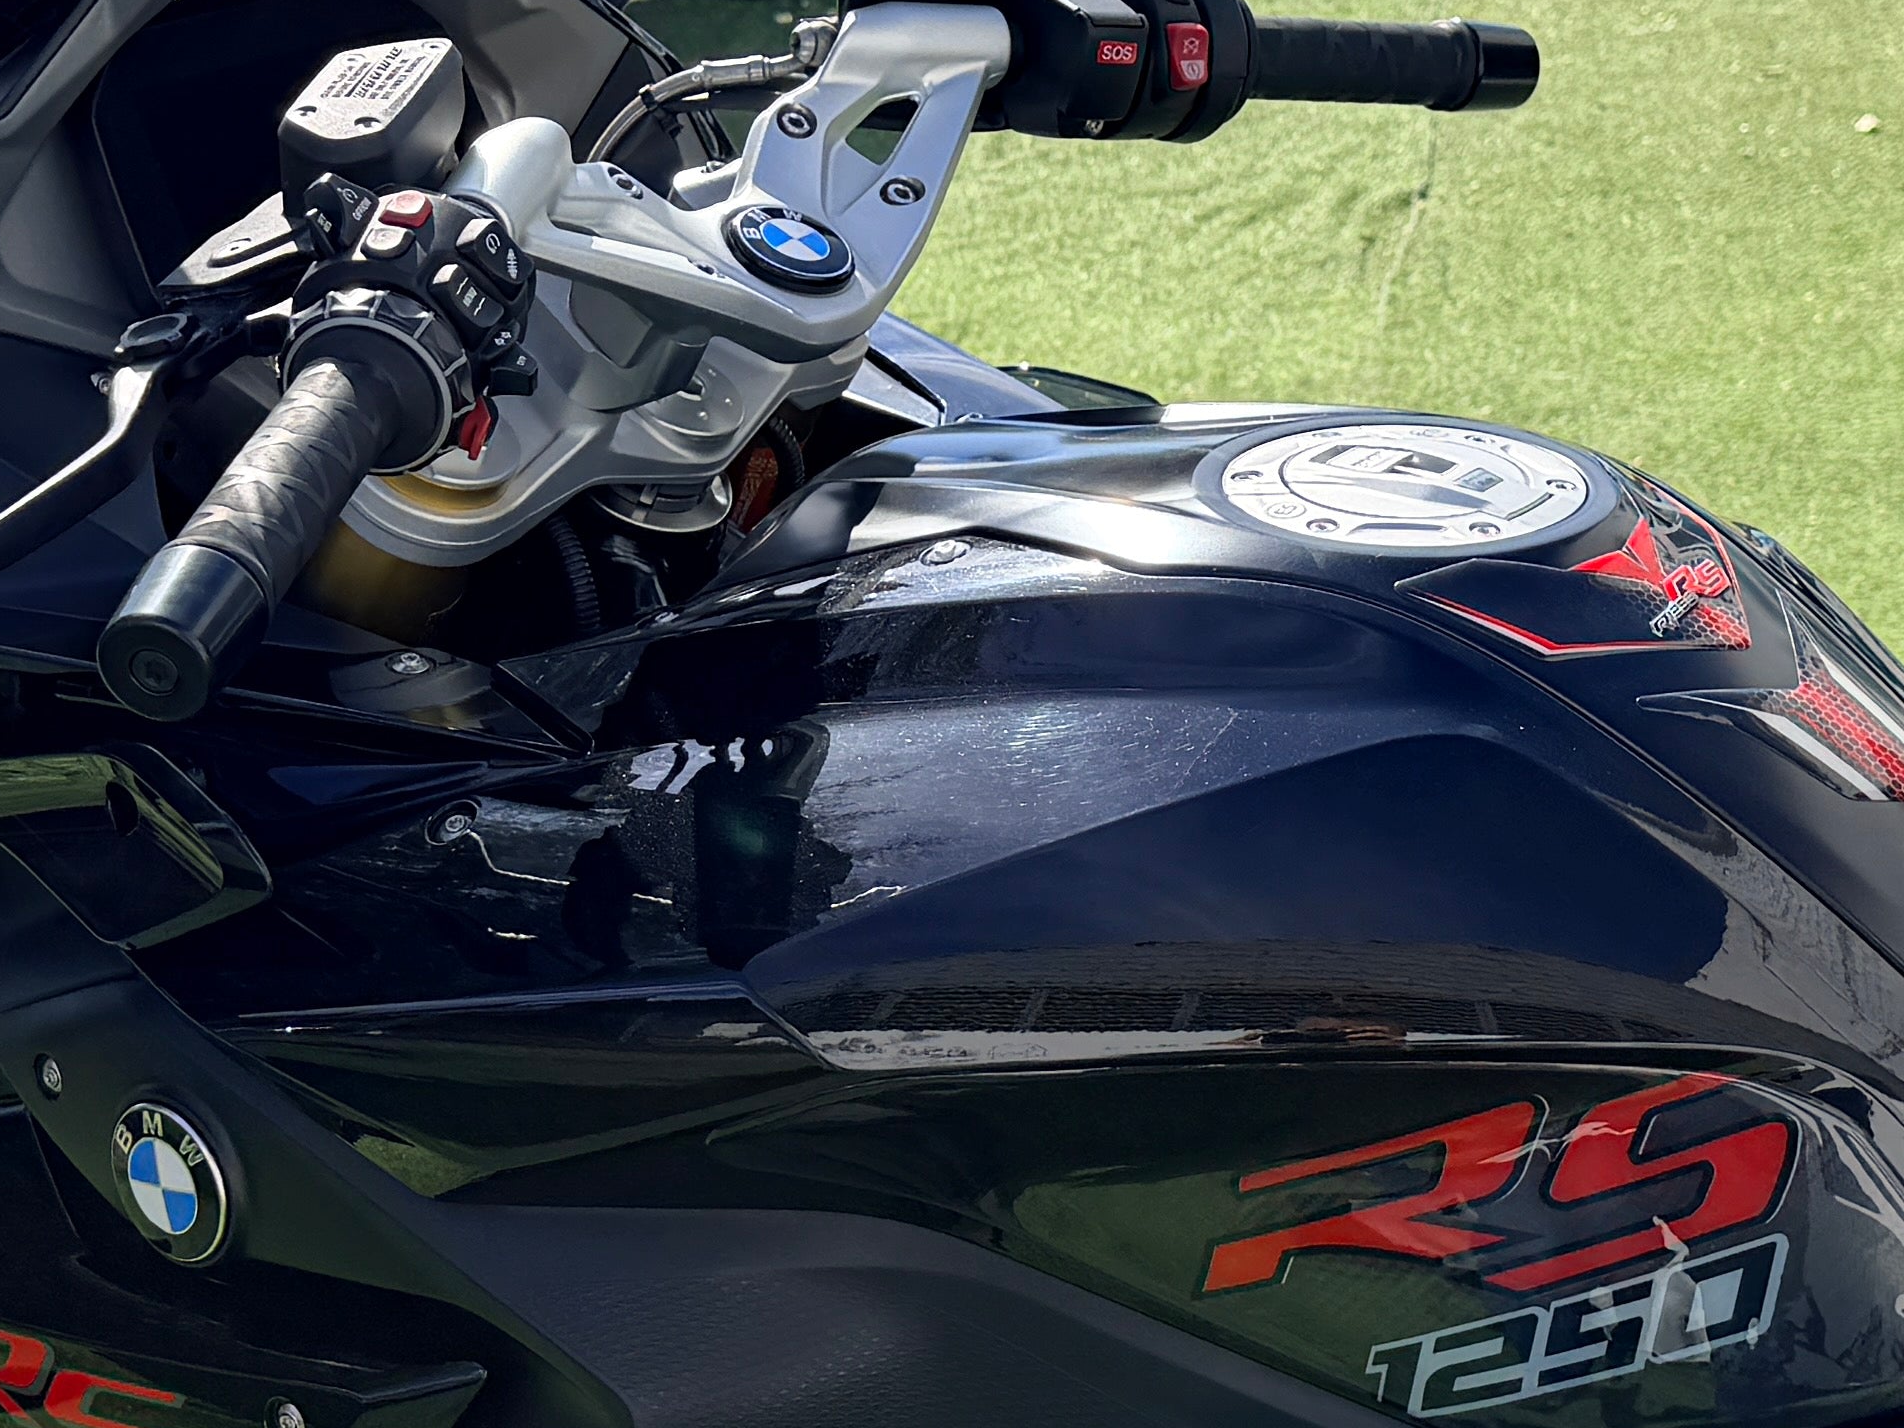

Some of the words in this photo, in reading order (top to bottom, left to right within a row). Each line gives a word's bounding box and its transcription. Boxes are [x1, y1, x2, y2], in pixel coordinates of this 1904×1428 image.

[1101, 44, 1133, 61] SOS
[742, 208, 803, 240] BMW
[1663, 558, 1732, 602] RS
[114, 1109, 204, 1168] BMW
[1202, 1071, 1792, 1294] RS
[1365, 1233, 1789, 1418] 1250
